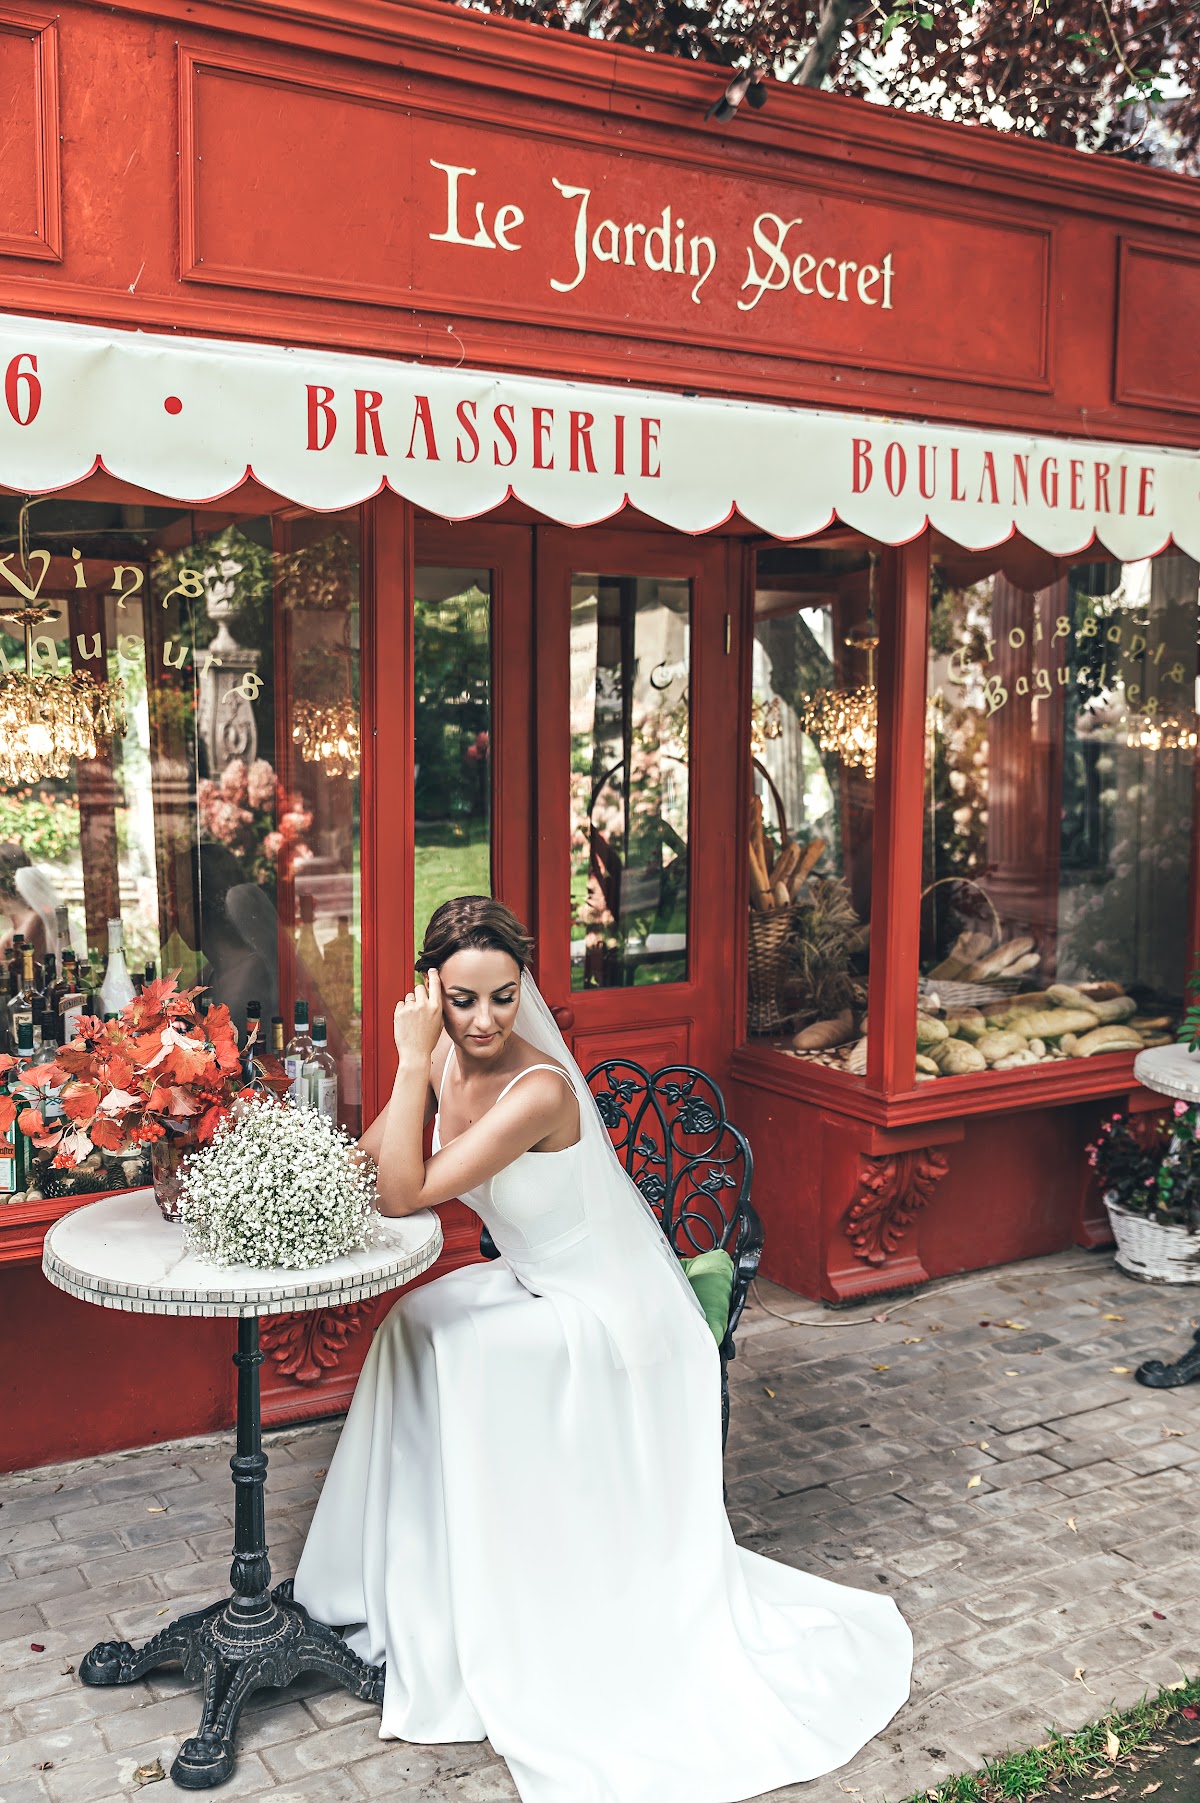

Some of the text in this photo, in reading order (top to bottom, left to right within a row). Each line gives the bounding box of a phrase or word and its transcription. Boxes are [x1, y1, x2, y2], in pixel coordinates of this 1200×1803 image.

[429, 158, 895, 311] Le Jardin Secret
[305, 384, 661, 478] BRASSERIE
[851, 438, 1156, 516] BOULANGERIE
[0, 547, 205, 609] Vins
